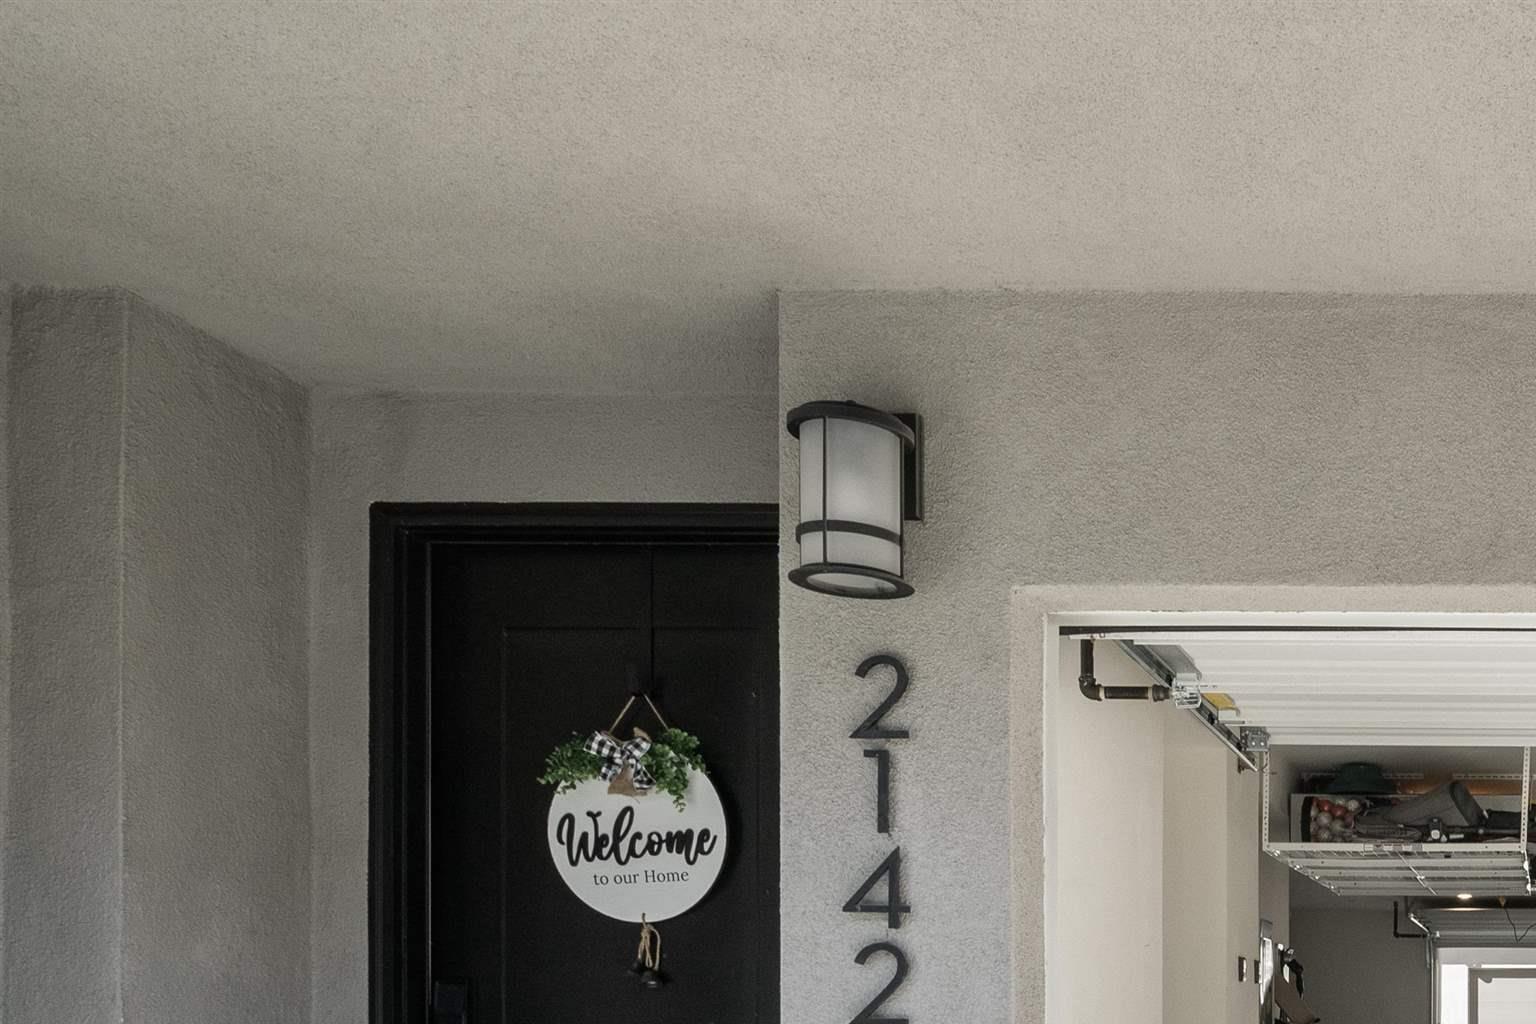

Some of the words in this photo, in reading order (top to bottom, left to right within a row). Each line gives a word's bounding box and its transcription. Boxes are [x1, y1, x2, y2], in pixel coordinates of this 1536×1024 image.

[556, 805, 717, 867] Welcome
[593, 873, 609, 886] to
[613, 872, 640, 885] our
[645, 869, 689, 883] Home
